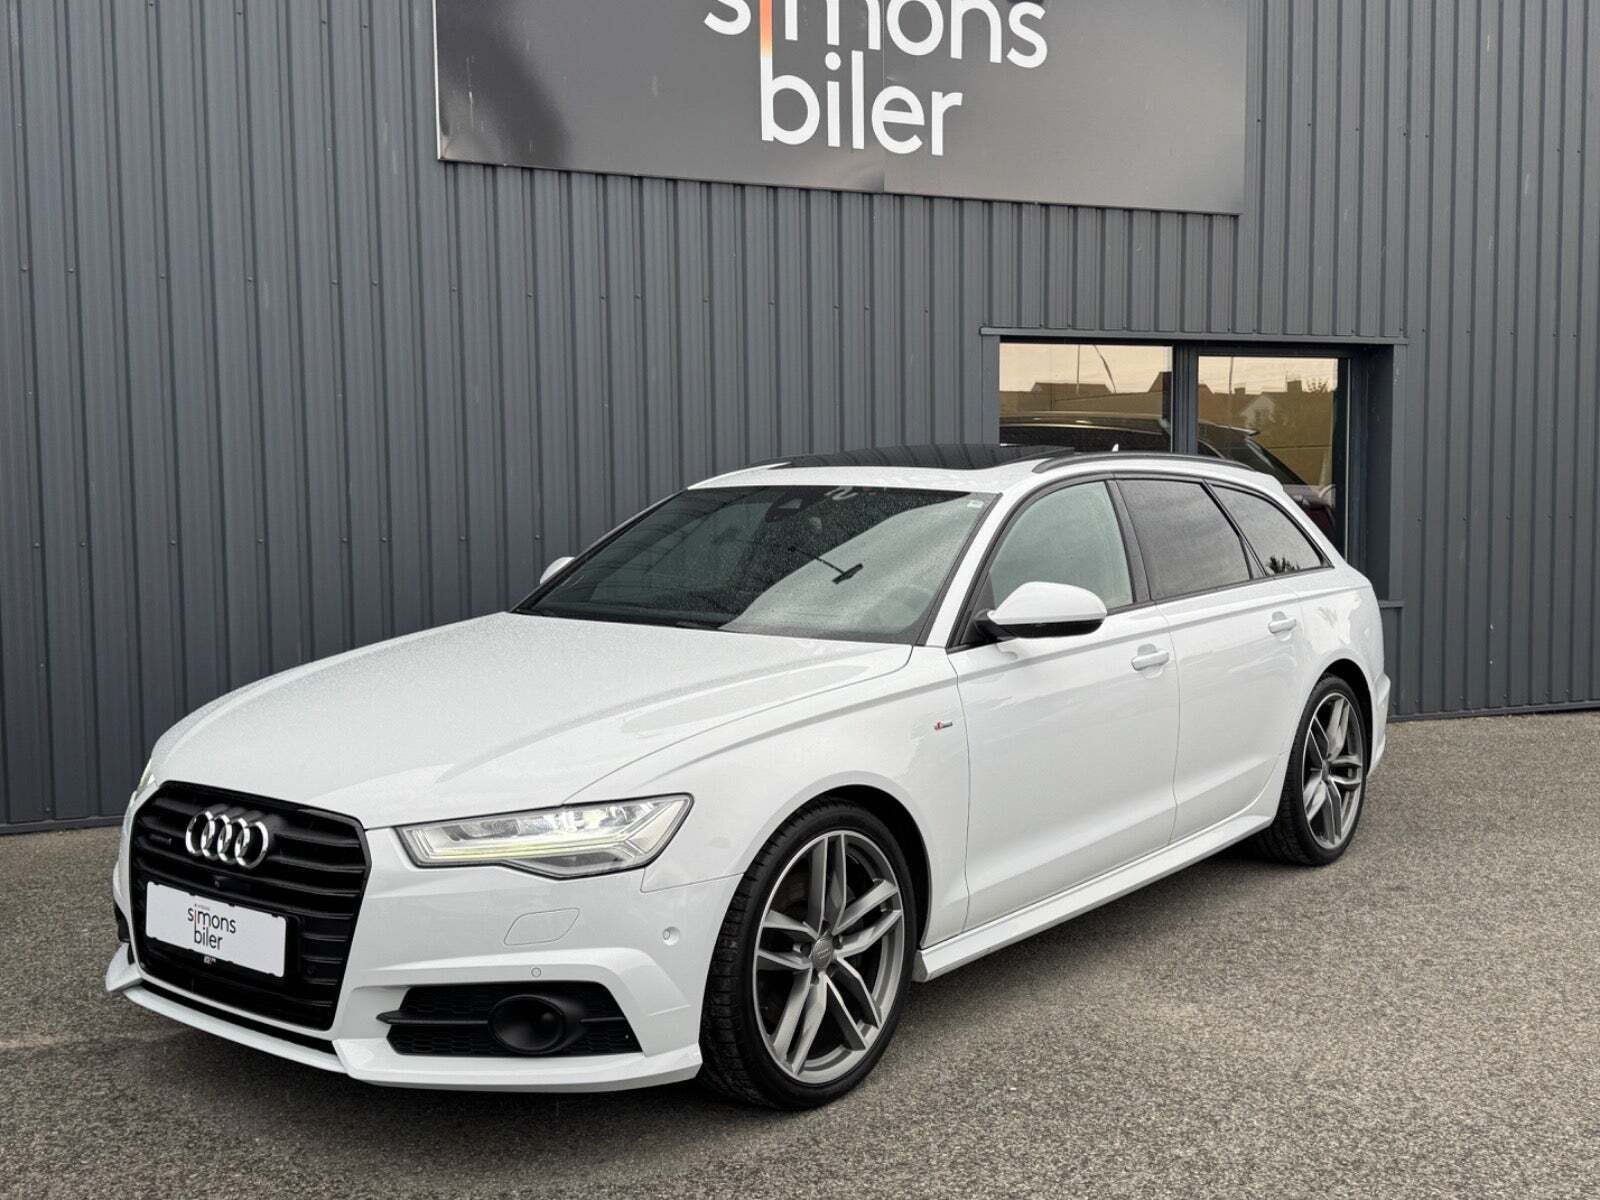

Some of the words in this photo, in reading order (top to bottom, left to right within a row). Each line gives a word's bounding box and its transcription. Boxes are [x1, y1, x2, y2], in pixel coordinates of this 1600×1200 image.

[759, 49, 963, 156] biler
[187, 905, 236, 934] simons
[194, 926, 223, 951] biler
